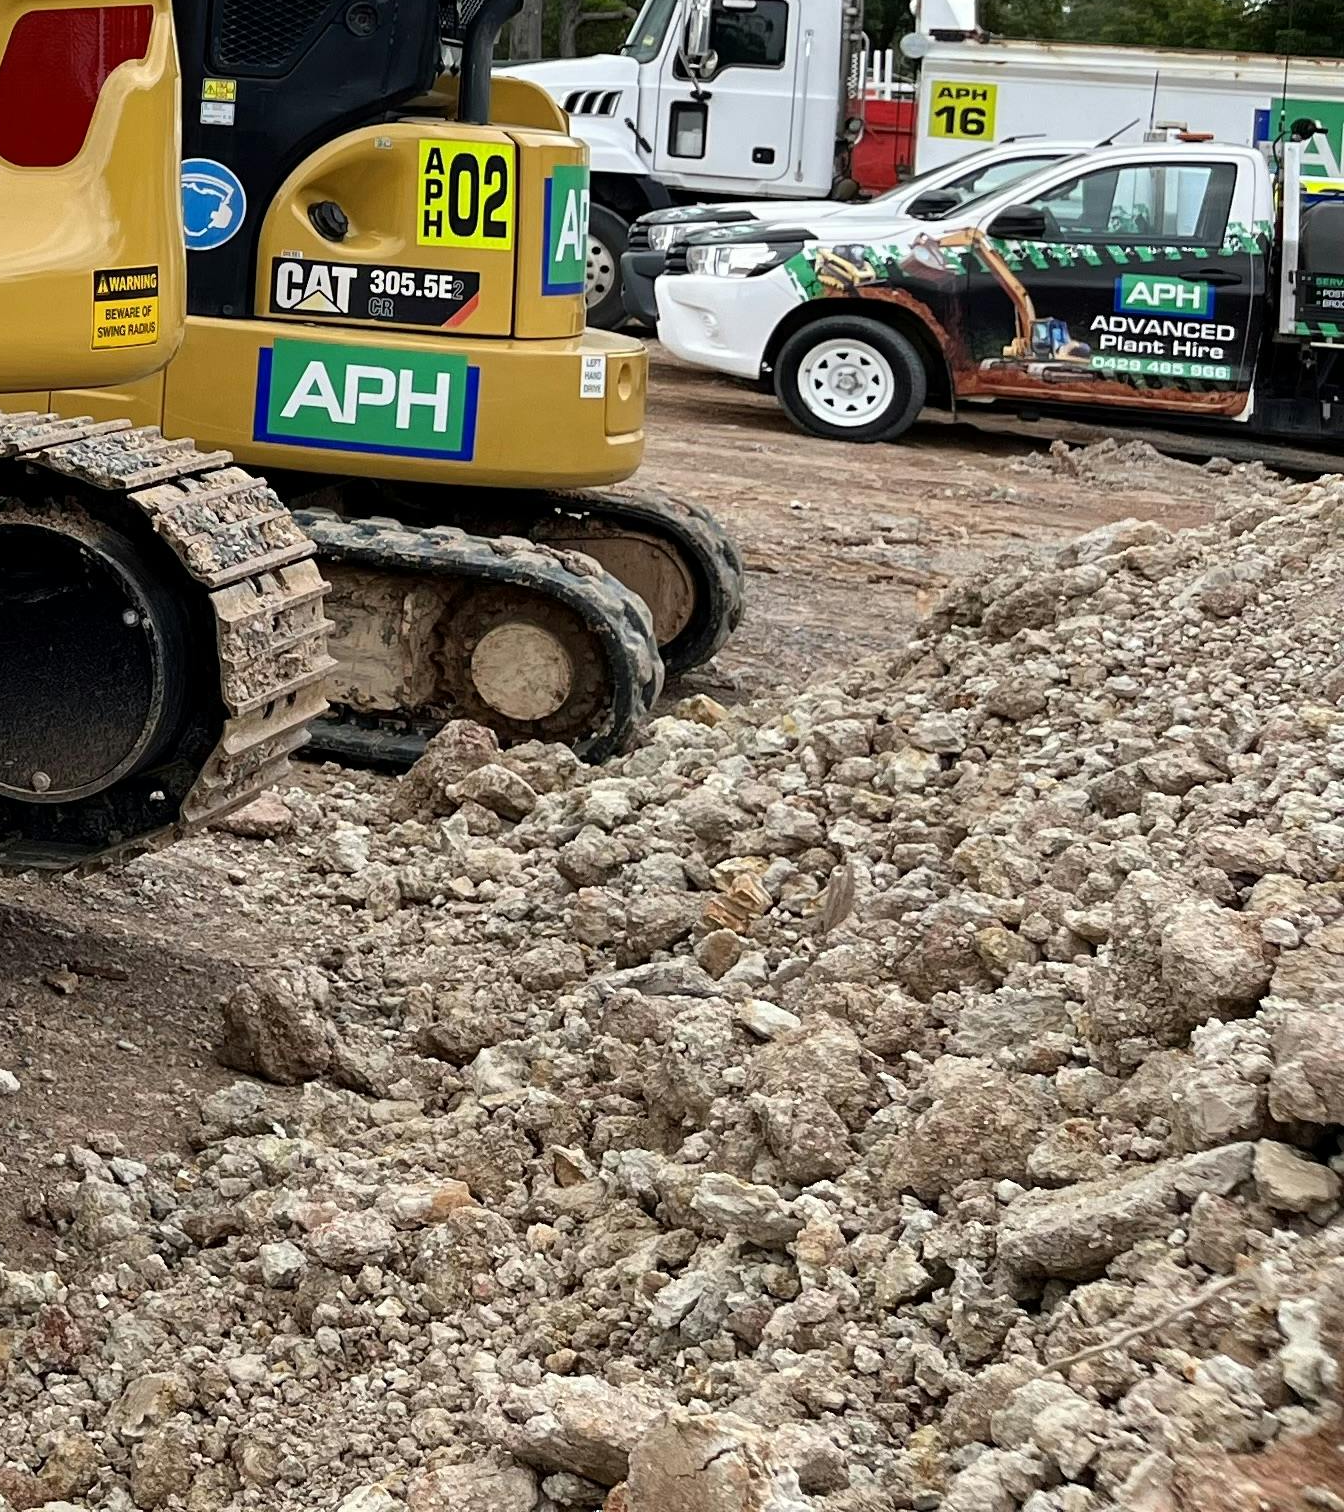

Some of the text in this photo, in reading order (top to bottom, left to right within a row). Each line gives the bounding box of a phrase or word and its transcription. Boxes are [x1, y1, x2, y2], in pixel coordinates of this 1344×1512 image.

[938, 87, 988, 101] APH
[934, 105, 987, 136] 16
[423, 147, 445, 238] APH
[448, 152, 508, 239] 02
[109, 273, 157, 292] WARNING
[275, 261, 358, 314] CAT
[1125, 281, 1201, 309] APH
[105, 304, 153, 320] BEWARE OF
[368, 296, 394, 317] CR
[97, 321, 156, 338] SWING RADIUS
[1090, 315, 1235, 341] ADVANCED
[1099, 333, 1225, 360] Plant Hire
[279, 360, 451, 433] APH
